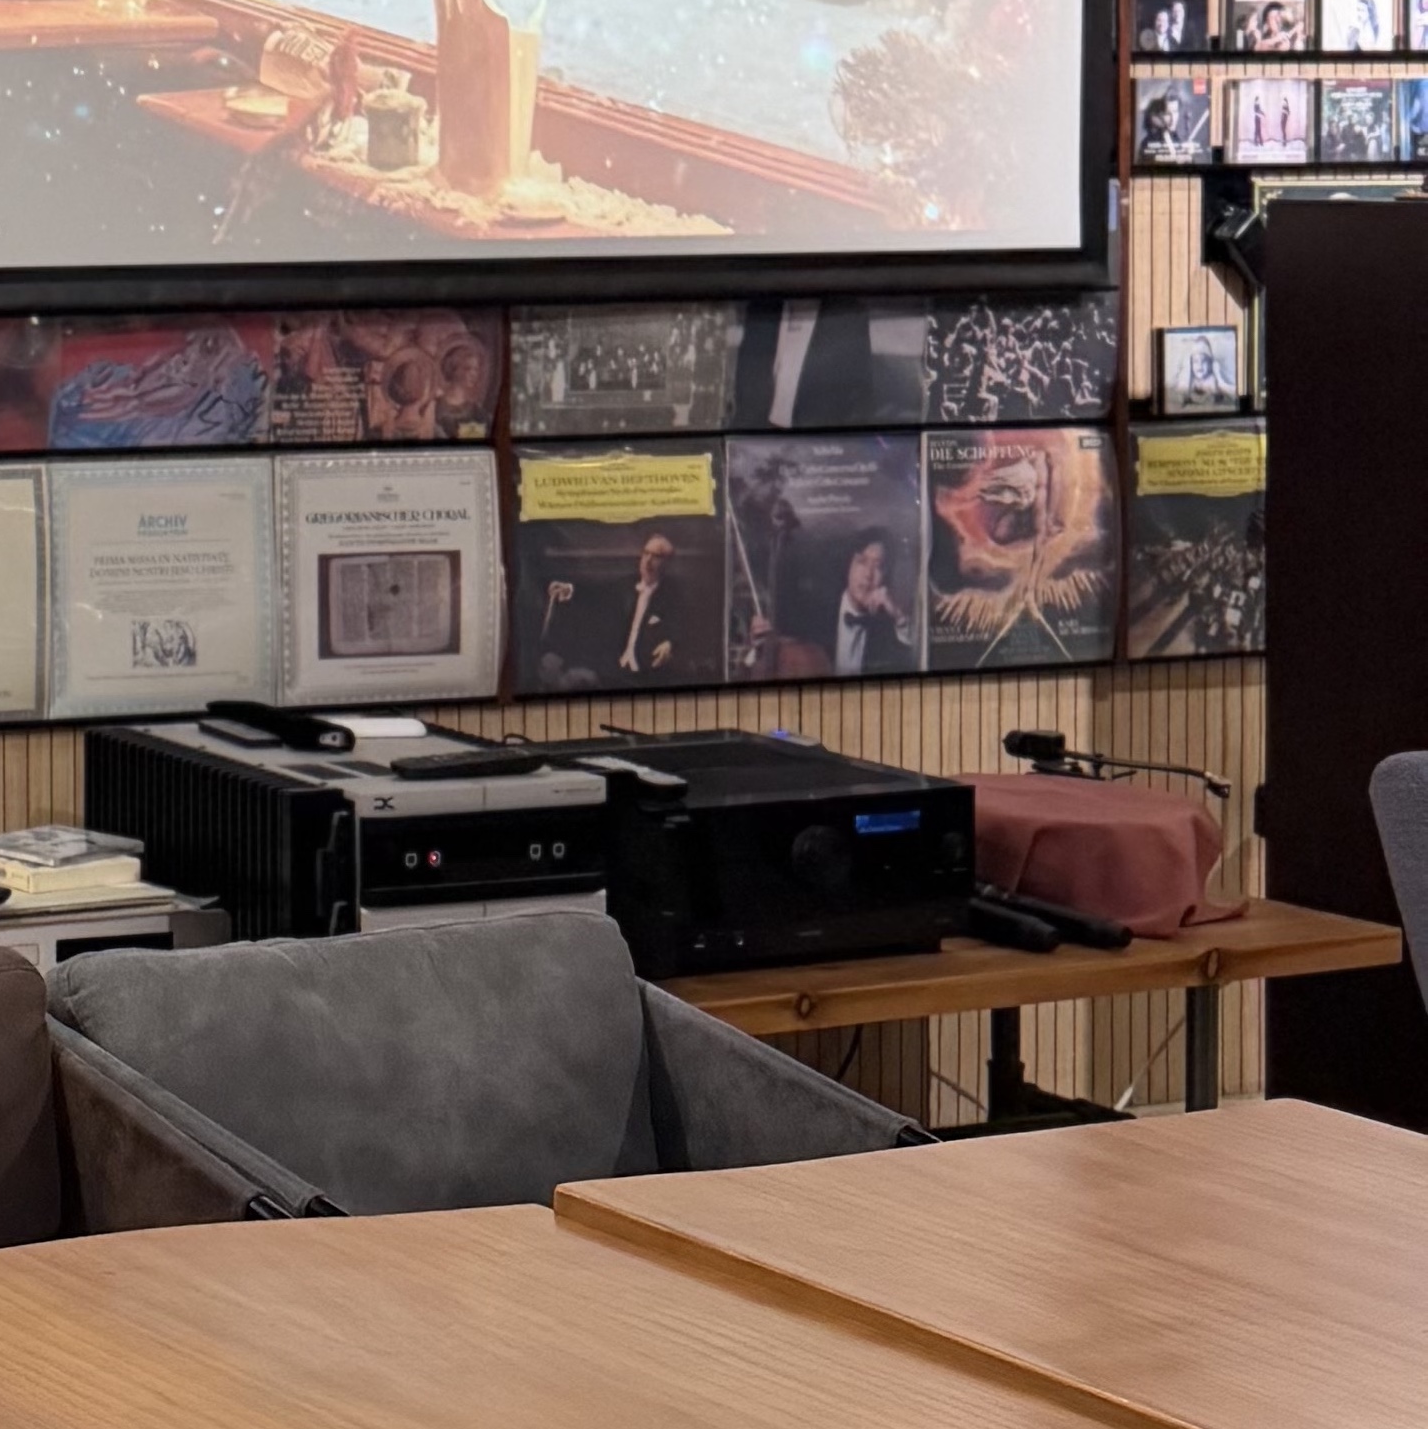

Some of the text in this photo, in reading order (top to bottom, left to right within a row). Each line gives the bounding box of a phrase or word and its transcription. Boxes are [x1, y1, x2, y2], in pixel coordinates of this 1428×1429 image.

[930, 448, 953, 461] DIE
[533, 473, 701, 489] LUDWIG VAN BEETHOVEN
[138, 515, 187, 528] ARCHIV
[305, 508, 470, 524] GREGORIANISCHER CHORAL
